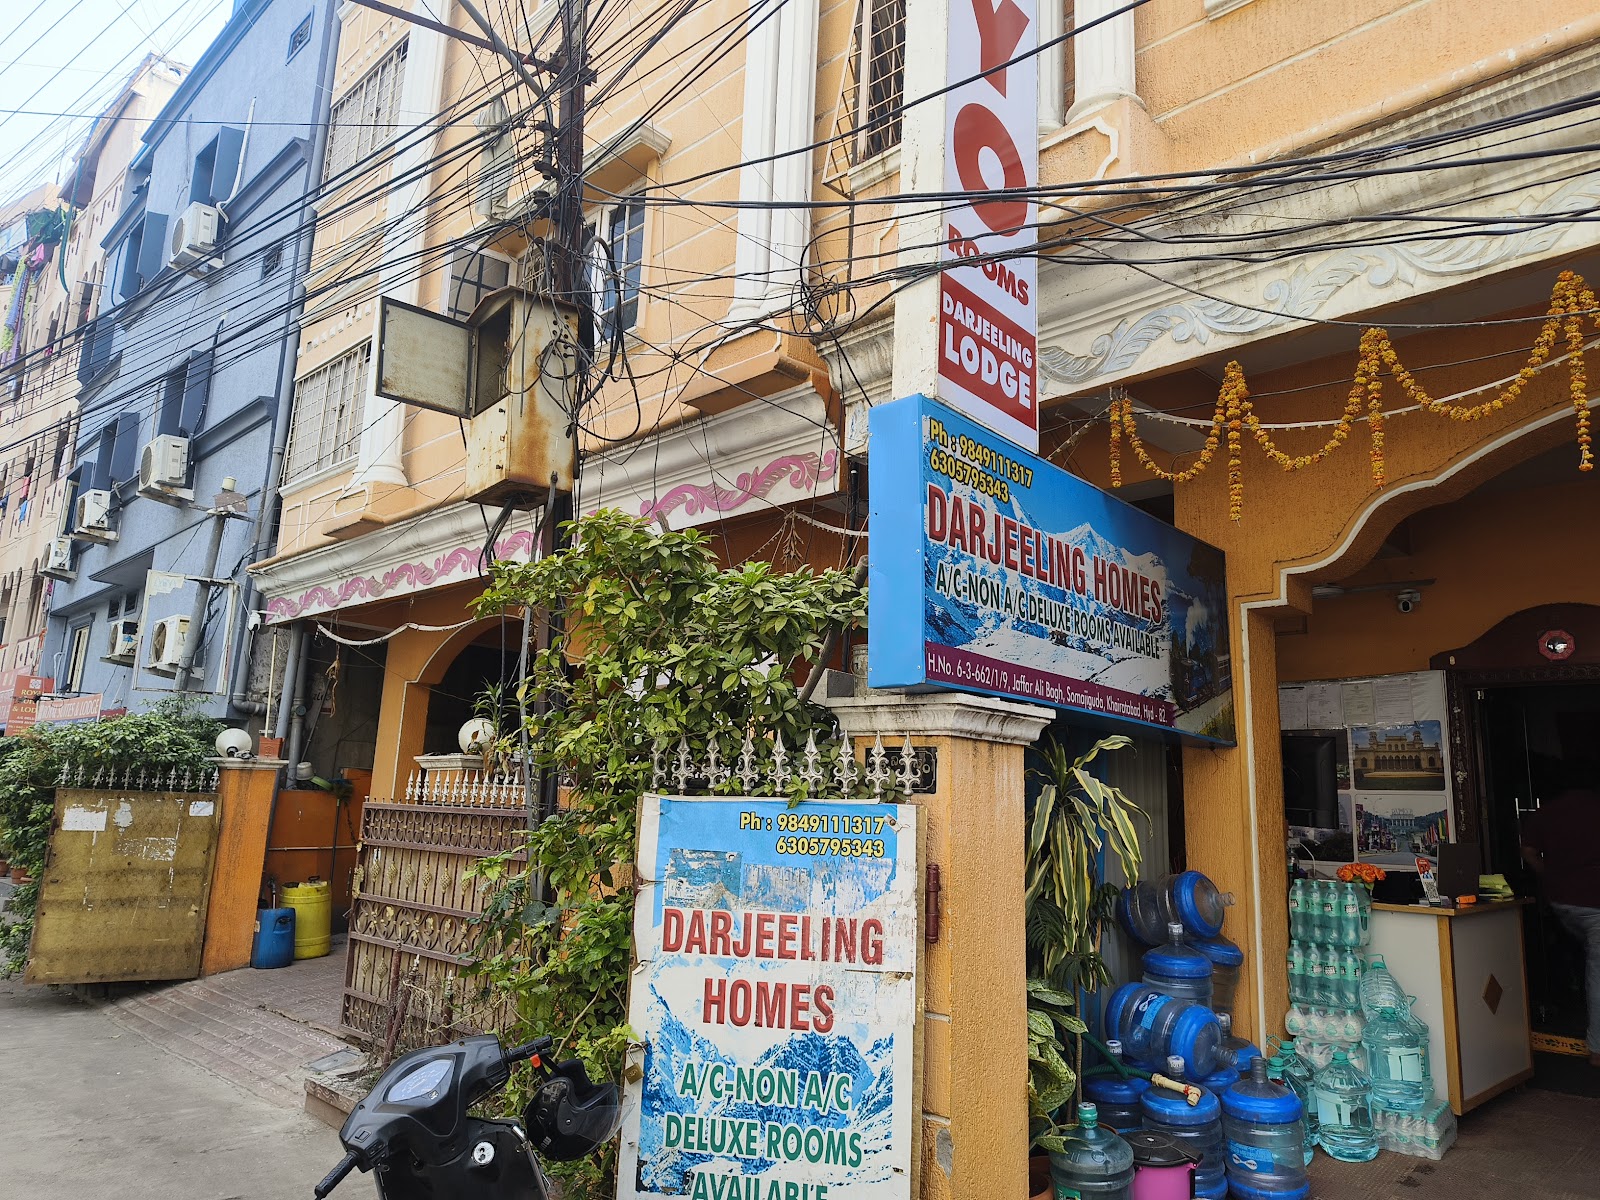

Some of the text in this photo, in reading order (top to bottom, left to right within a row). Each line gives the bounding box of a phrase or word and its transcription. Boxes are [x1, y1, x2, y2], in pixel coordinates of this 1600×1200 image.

[948, 223, 1029, 306] ROOMS
[942, 291, 1033, 369] DARJEELING
[945, 322, 1031, 409] LODGE
[929, 417, 948, 448] Ph
[959, 433, 1033, 489] 9849111317
[930, 447, 1010, 504] 6305795343
[928, 484, 1162, 624] DARJEELING HOMES
[936, 563, 1160, 660] A/C-NON A/C DELUXE ROOMS AVAILABLE
[928, 653, 954, 676] H.No.
[956, 659, 1011, 692] 6-3-662/1/9,
[1012, 673, 1033, 694] Jaffar
[1034, 678, 1044, 695] Ali
[1045, 681, 1066, 705] Bagh,
[1067, 686, 1106, 712] Somajiguda,
[740, 812, 762, 830] Ph
[777, 813, 885, 835] 9849111317
[776, 836, 885, 858] 6305795343
[662, 908, 883, 966] DARJEELING
[702, 977, 835, 1034] HOMES
[680, 1063, 850, 1113] A/C-NON A/C
[665, 1114, 862, 1168] DELUXE ROOMS
